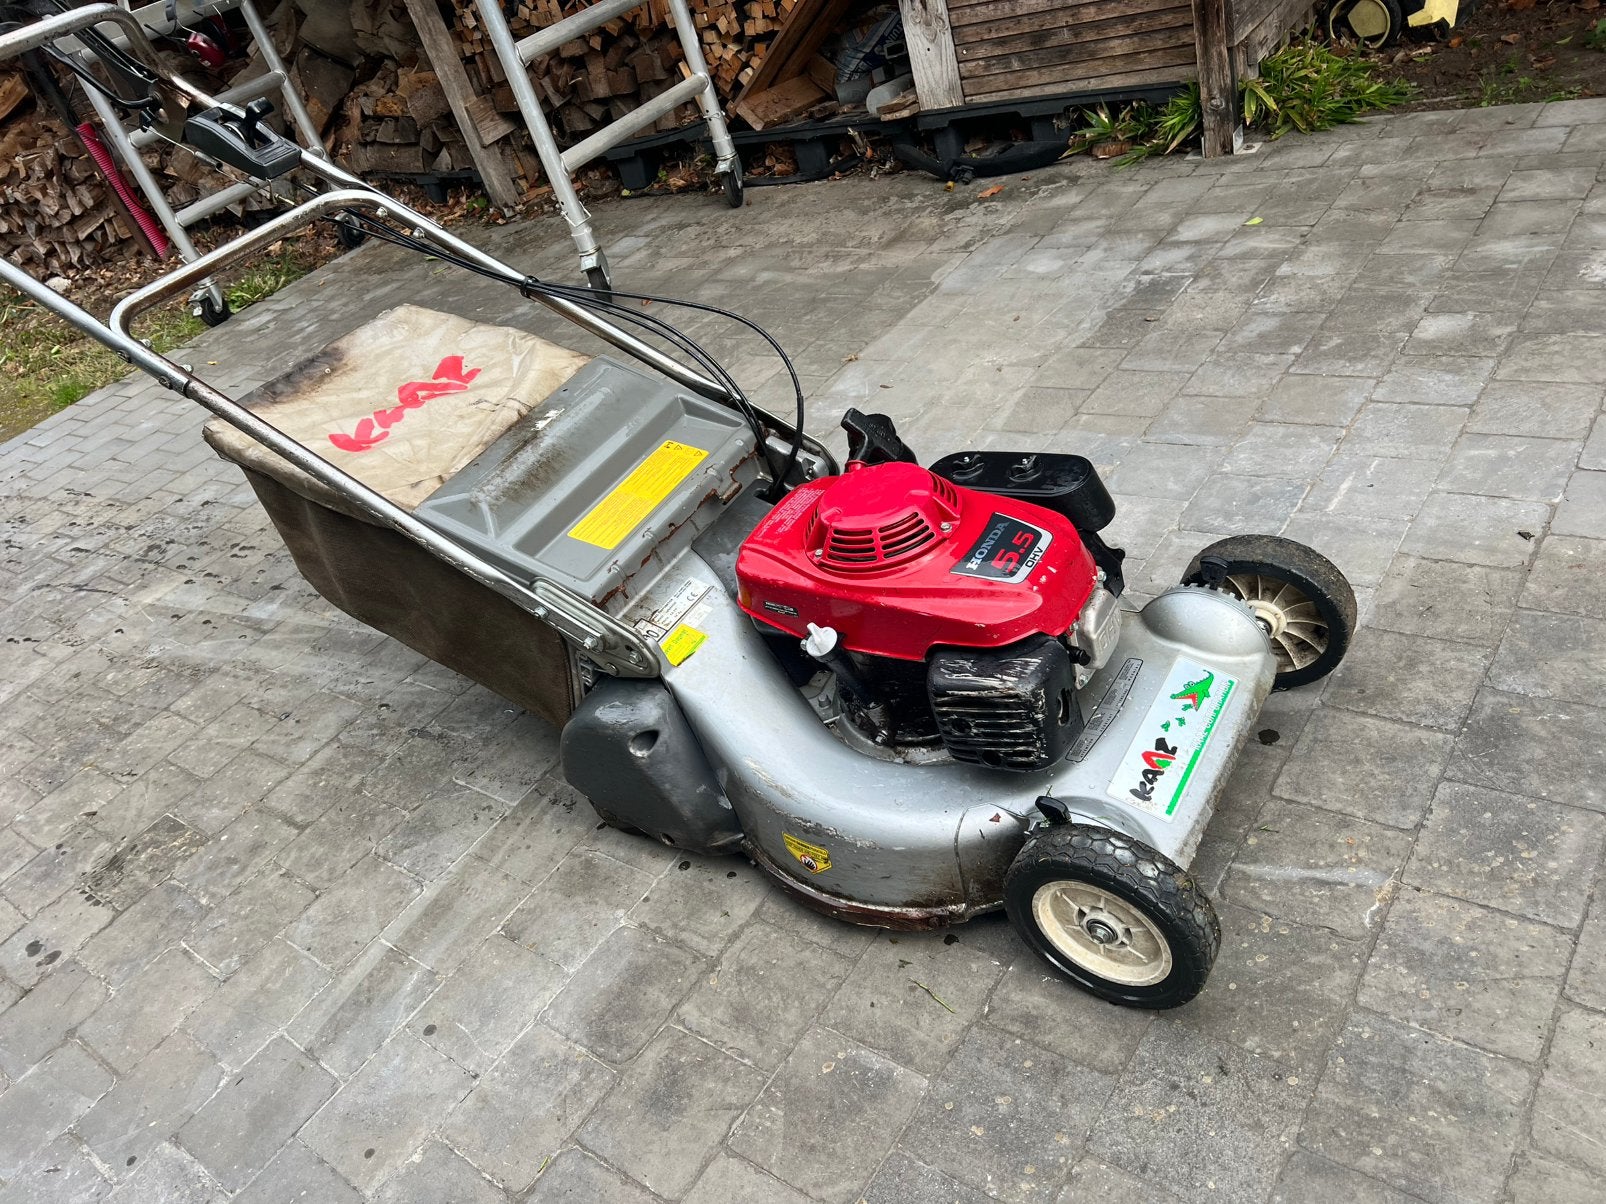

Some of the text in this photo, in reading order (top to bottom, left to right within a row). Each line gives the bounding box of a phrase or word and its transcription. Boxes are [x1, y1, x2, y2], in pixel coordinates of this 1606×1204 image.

[965, 521, 1011, 571] HONDA
[991, 531, 1034, 573] 5.5
[1025, 546, 1043, 568] OHV
[1129, 737, 1178, 801] KAAZ
